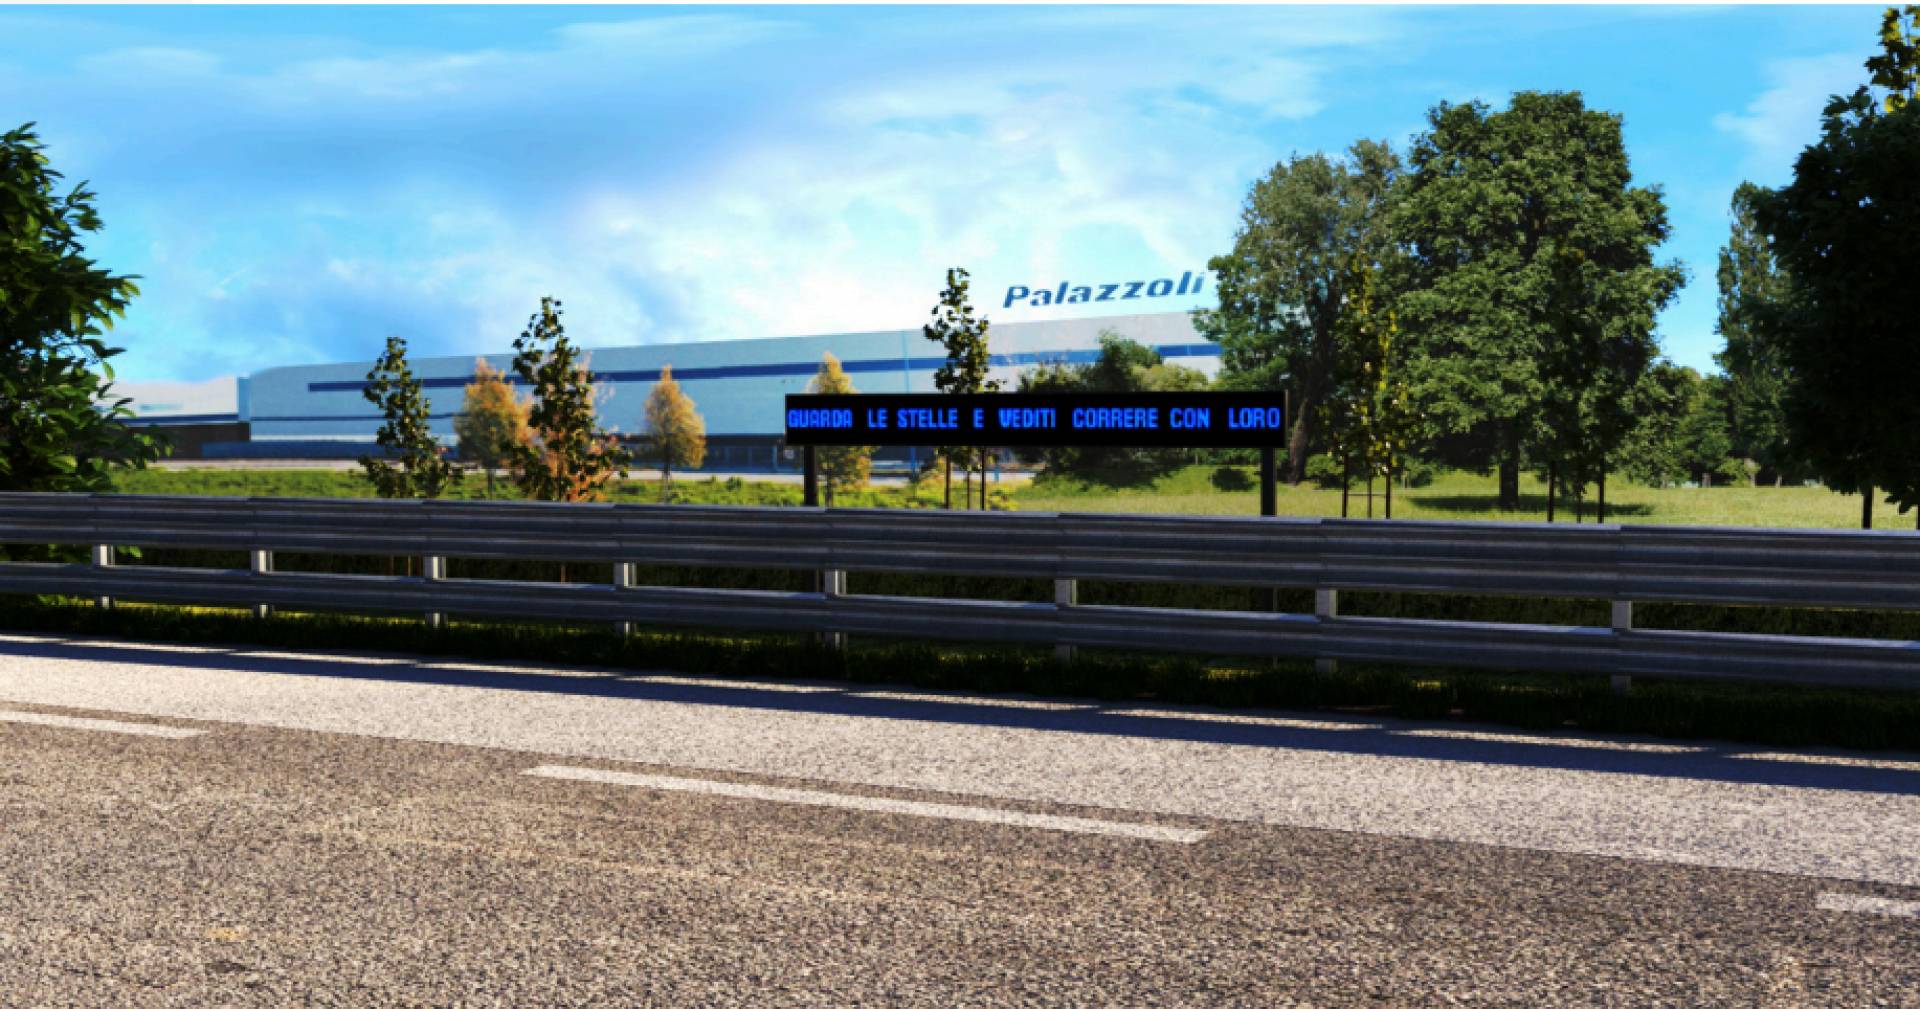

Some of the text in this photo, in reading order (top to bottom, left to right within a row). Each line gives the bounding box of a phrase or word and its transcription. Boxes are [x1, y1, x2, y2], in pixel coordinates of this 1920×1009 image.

[1002, 271, 1206, 308] Palazzoli
[788, 408, 1281, 429] GUARDA LE STELLE E VEDITI CORRERE CON LORO
